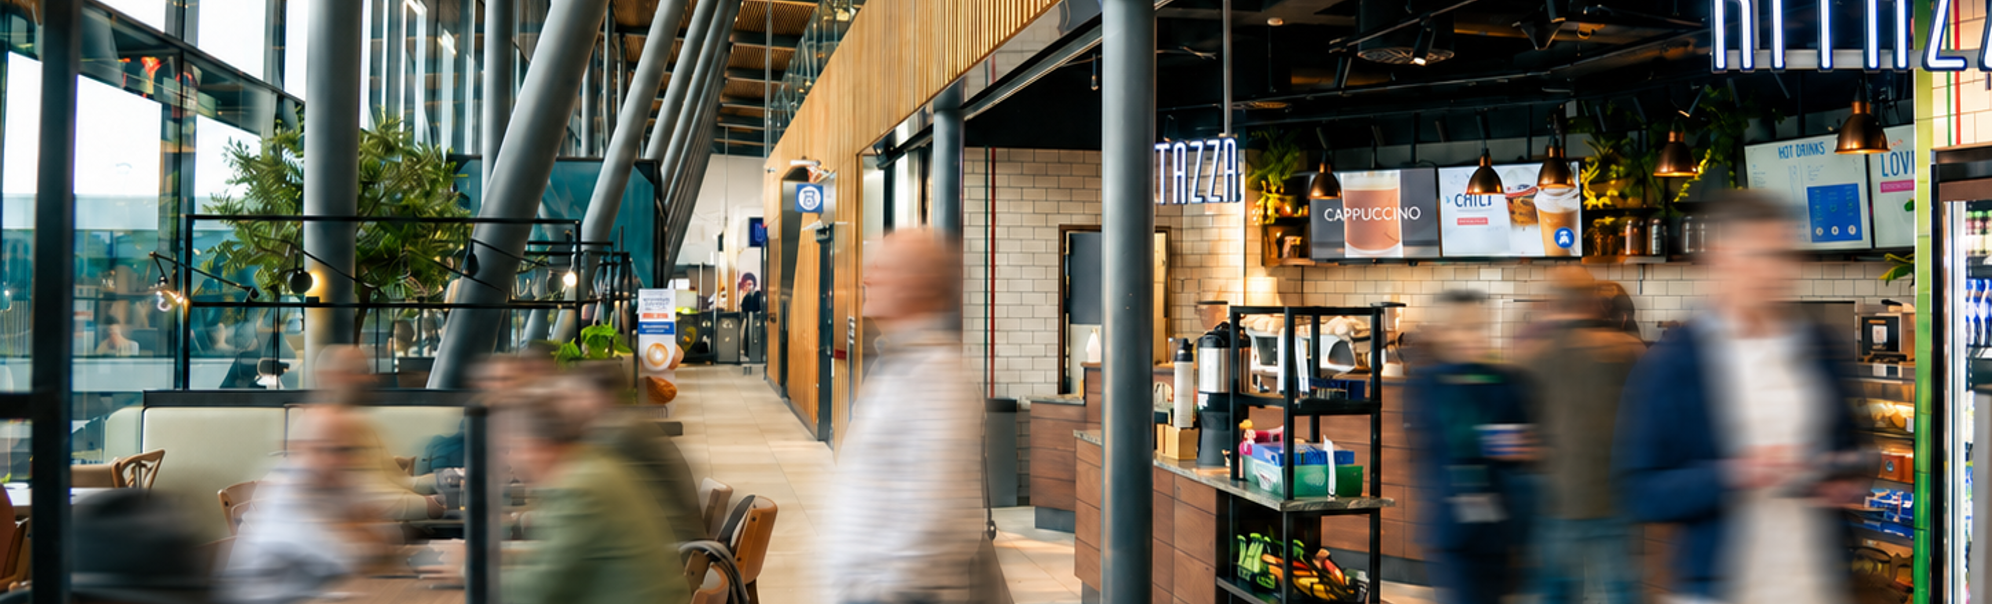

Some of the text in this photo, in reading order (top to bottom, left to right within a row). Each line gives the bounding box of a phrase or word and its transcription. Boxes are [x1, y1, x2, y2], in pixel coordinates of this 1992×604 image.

[1778, 141, 1826, 159] HOT DRINKS
[1154, 137, 1240, 205] TAZZA
[1324, 206, 1421, 222] CAPPUCCINO
